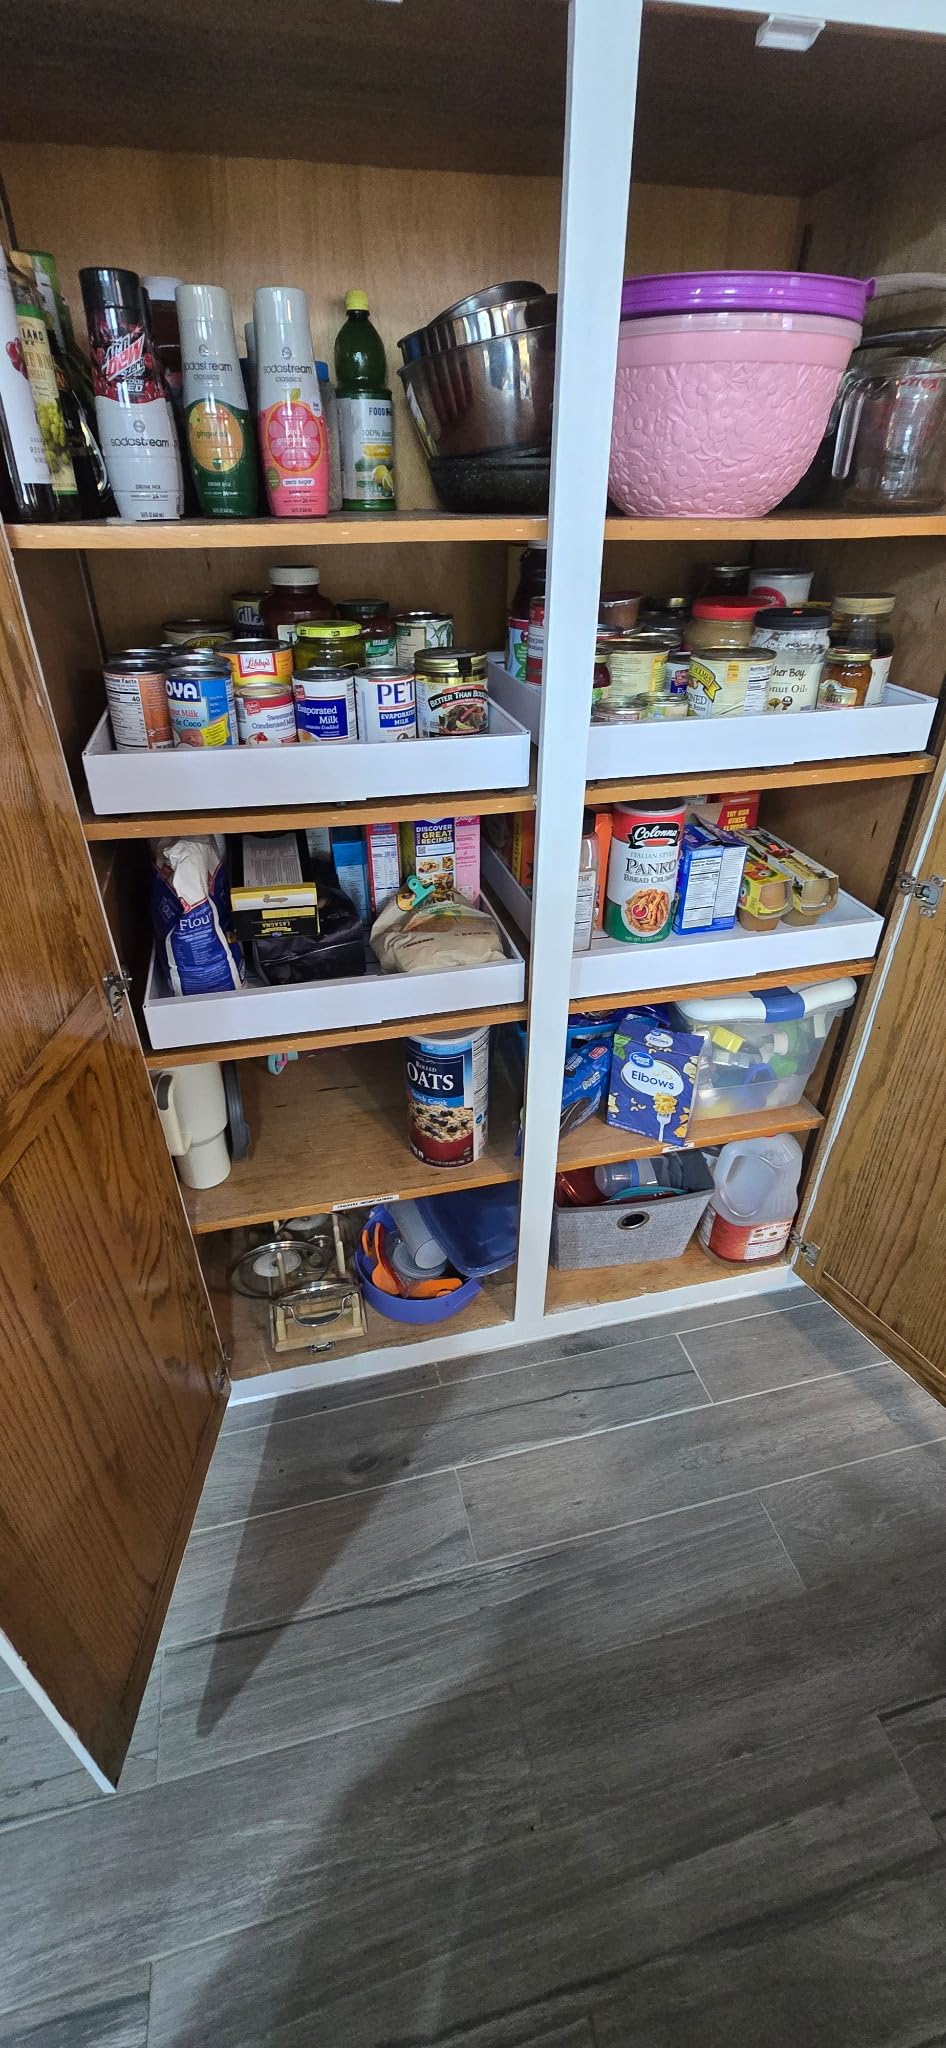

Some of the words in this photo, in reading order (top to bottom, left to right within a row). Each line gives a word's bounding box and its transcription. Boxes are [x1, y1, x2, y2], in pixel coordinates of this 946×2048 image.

[263, 363, 313, 375] sodastream
[110, 436, 170, 448] sodastream
[165, 680, 199, 699] OYA
[377, 680, 415, 705] PET
[319, 714, 339, 725] Milk
[416, 824, 453, 833] DISCOVER
[422, 830, 453, 839] GREAT
[634, 826, 678, 840] Colonna
[422, 836, 453, 845] RECIPES
[630, 852, 657, 860] ITALIAN
[625, 858, 677, 875] PANKO
[624, 873, 649, 884] BREAD
[179, 911, 212, 931] Flour
[406, 1061, 454, 1091] OATS
[631, 1070, 675, 1090] Elbows
